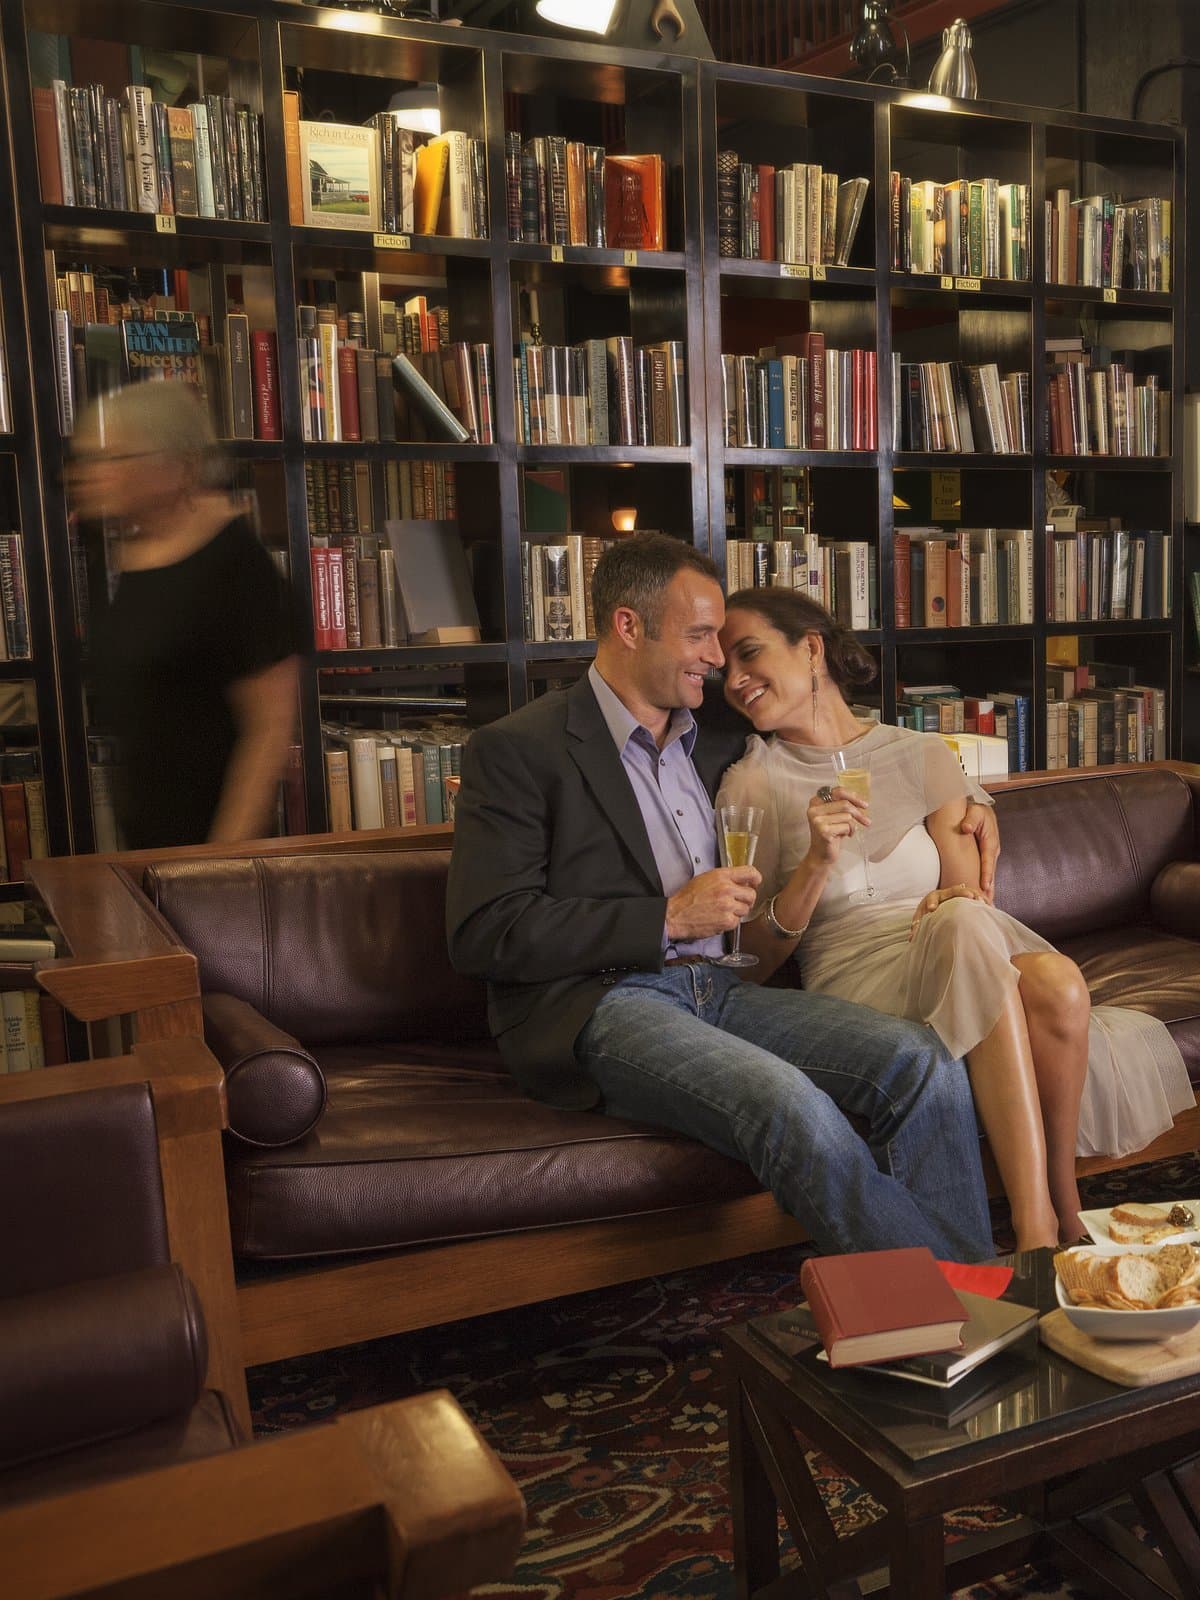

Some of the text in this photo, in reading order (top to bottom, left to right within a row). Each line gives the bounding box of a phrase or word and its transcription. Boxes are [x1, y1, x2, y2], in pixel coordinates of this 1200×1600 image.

[309, 126, 369, 141] Rich in Love
[454, 135, 465, 175] CHRISTINA
[161, 217, 172, 229] H
[376, 236, 408, 248] Fiction
[784, 266, 808, 277] ction
[815, 267, 823, 277] K
[957, 281, 980, 289] Fiction
[1105, 290, 1115, 300] M
[126, 322, 169, 337] EVAN
[128, 337, 200, 352] HUNTER
[58, 335, 69, 378] LOUISIANA
[129, 353, 200, 368] Streets of
[813, 354, 823, 404] Westward Ho!
[790, 368, 798, 407] Hanging
[262, 392, 270, 425] Christina
[2, 558, 13, 589] HUMAN
[5, 590, 16, 621] FACTOR
